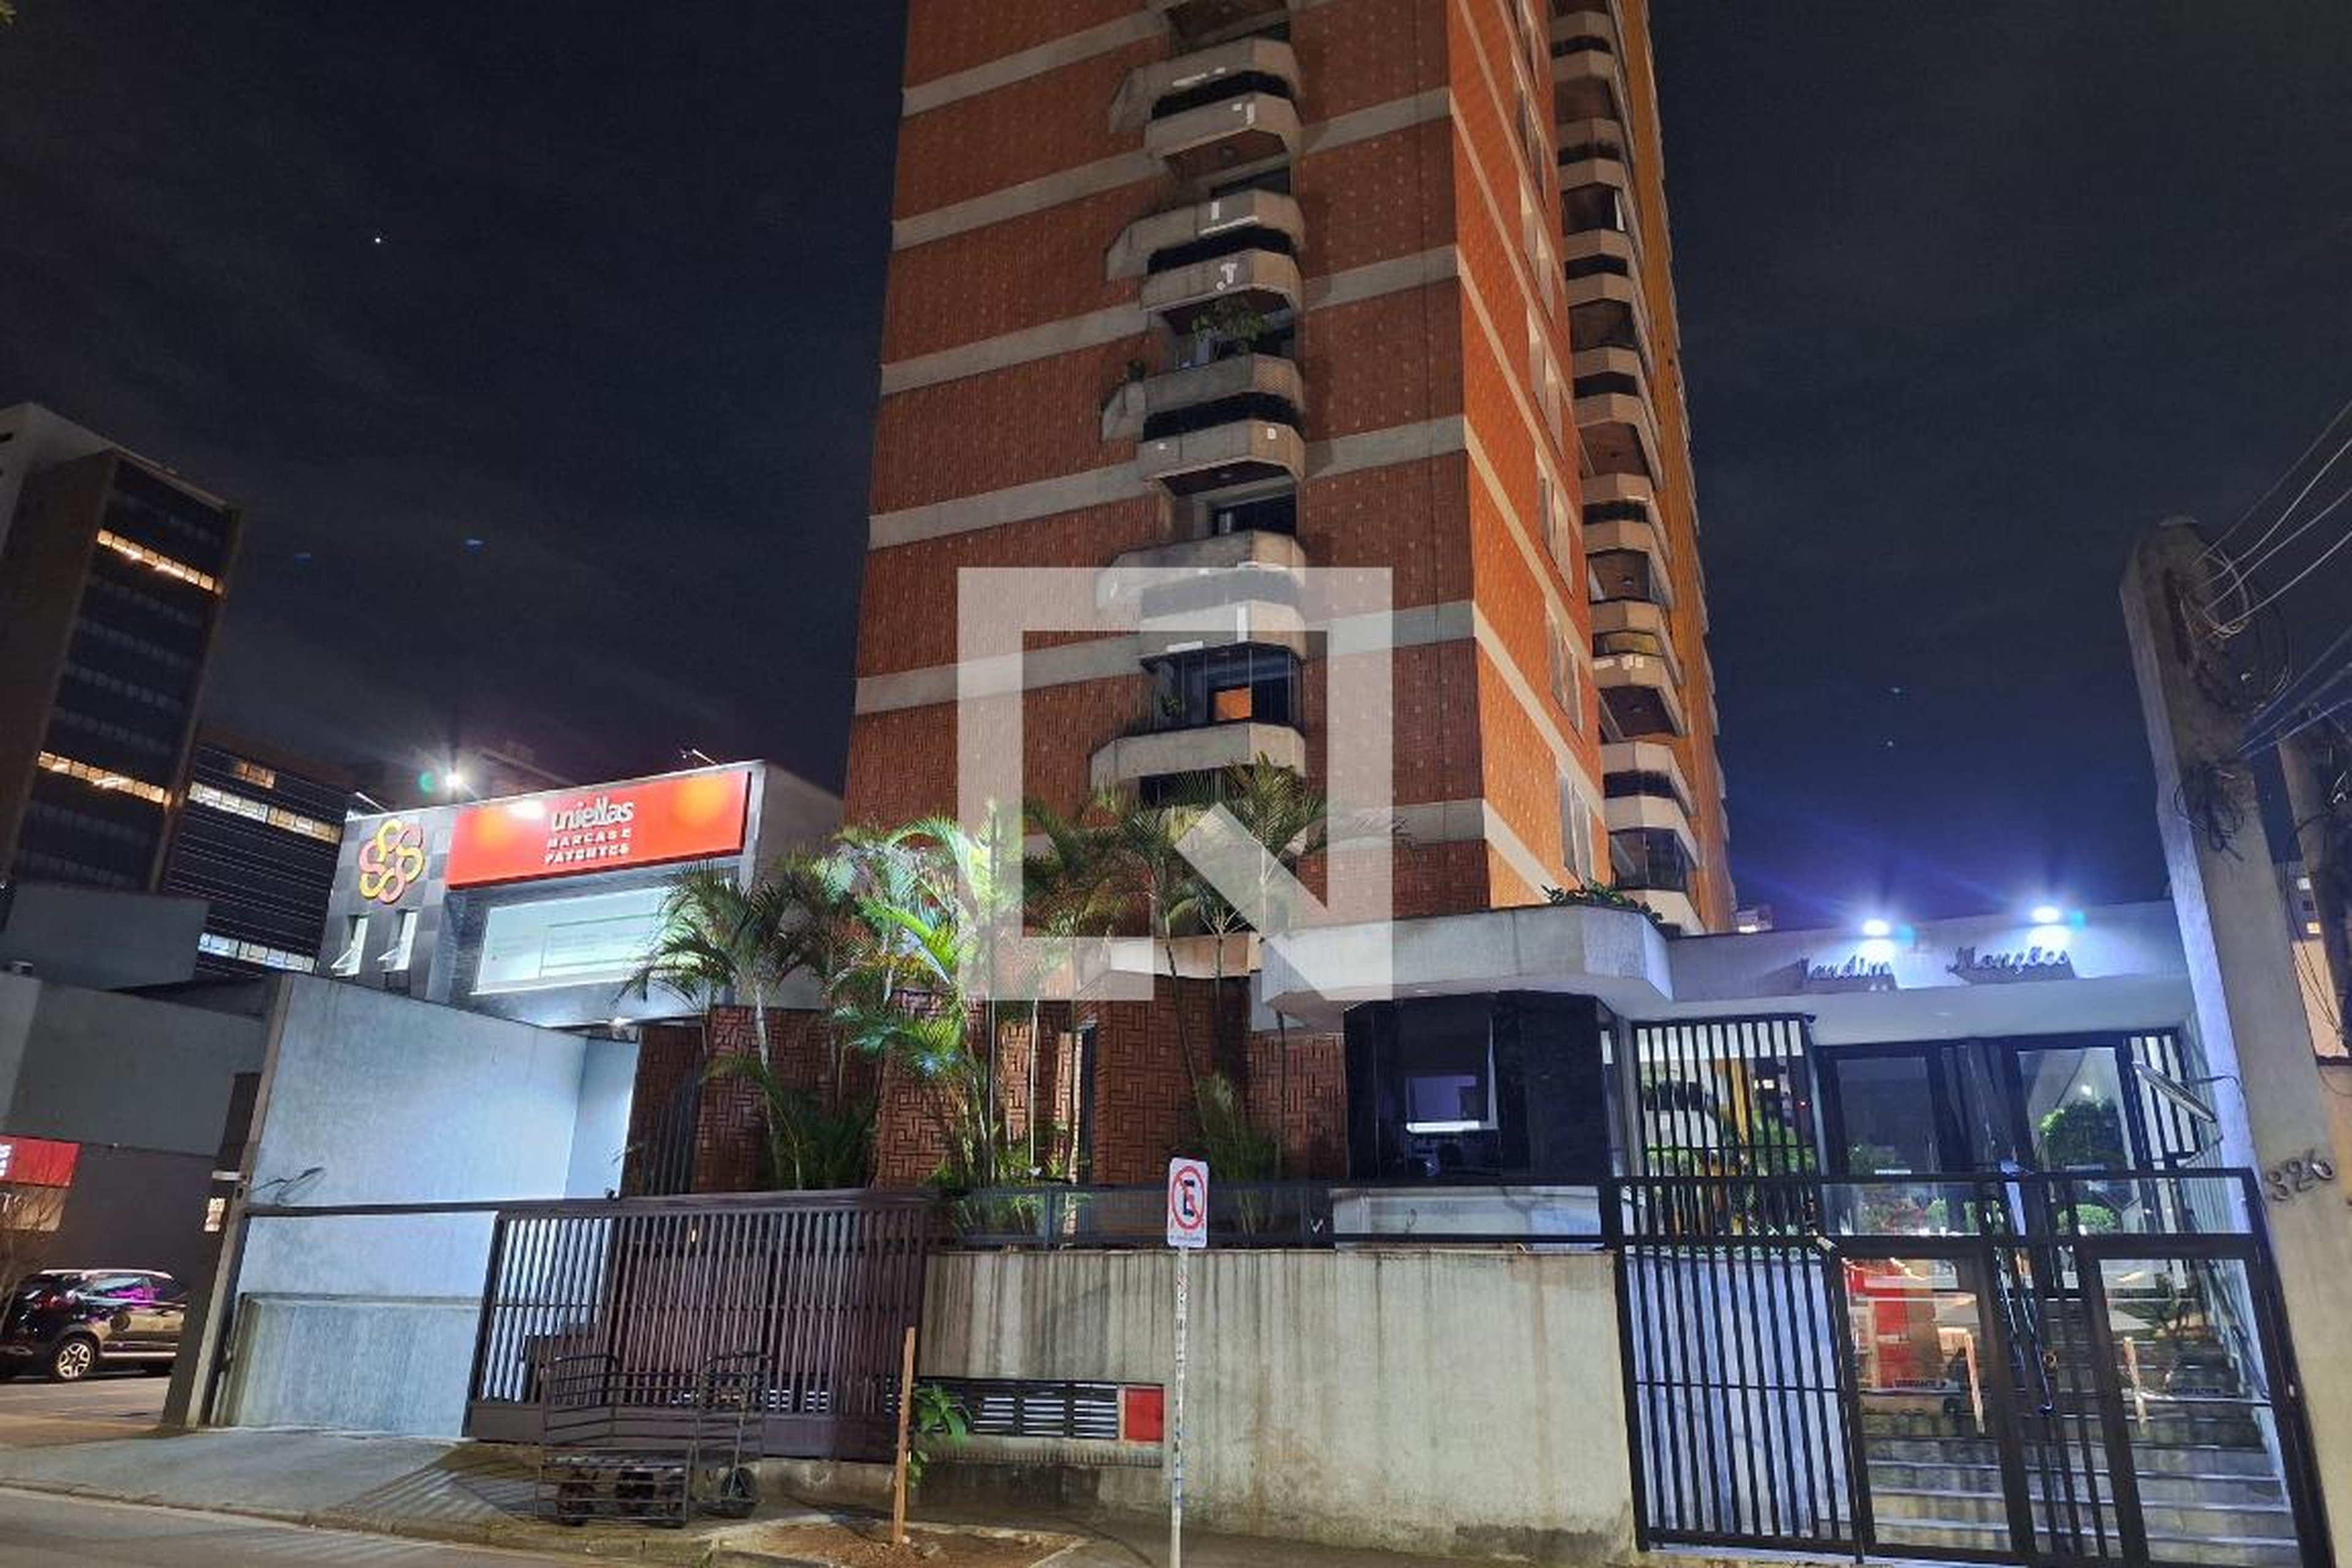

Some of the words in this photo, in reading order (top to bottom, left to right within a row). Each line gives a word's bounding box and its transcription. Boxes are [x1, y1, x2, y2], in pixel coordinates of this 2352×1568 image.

[546, 831, 617, 850] MARCAS
[622, 829, 631, 839] E
[544, 843, 630, 864] PATENTES
[2266, 1148, 2334, 1202] 326
